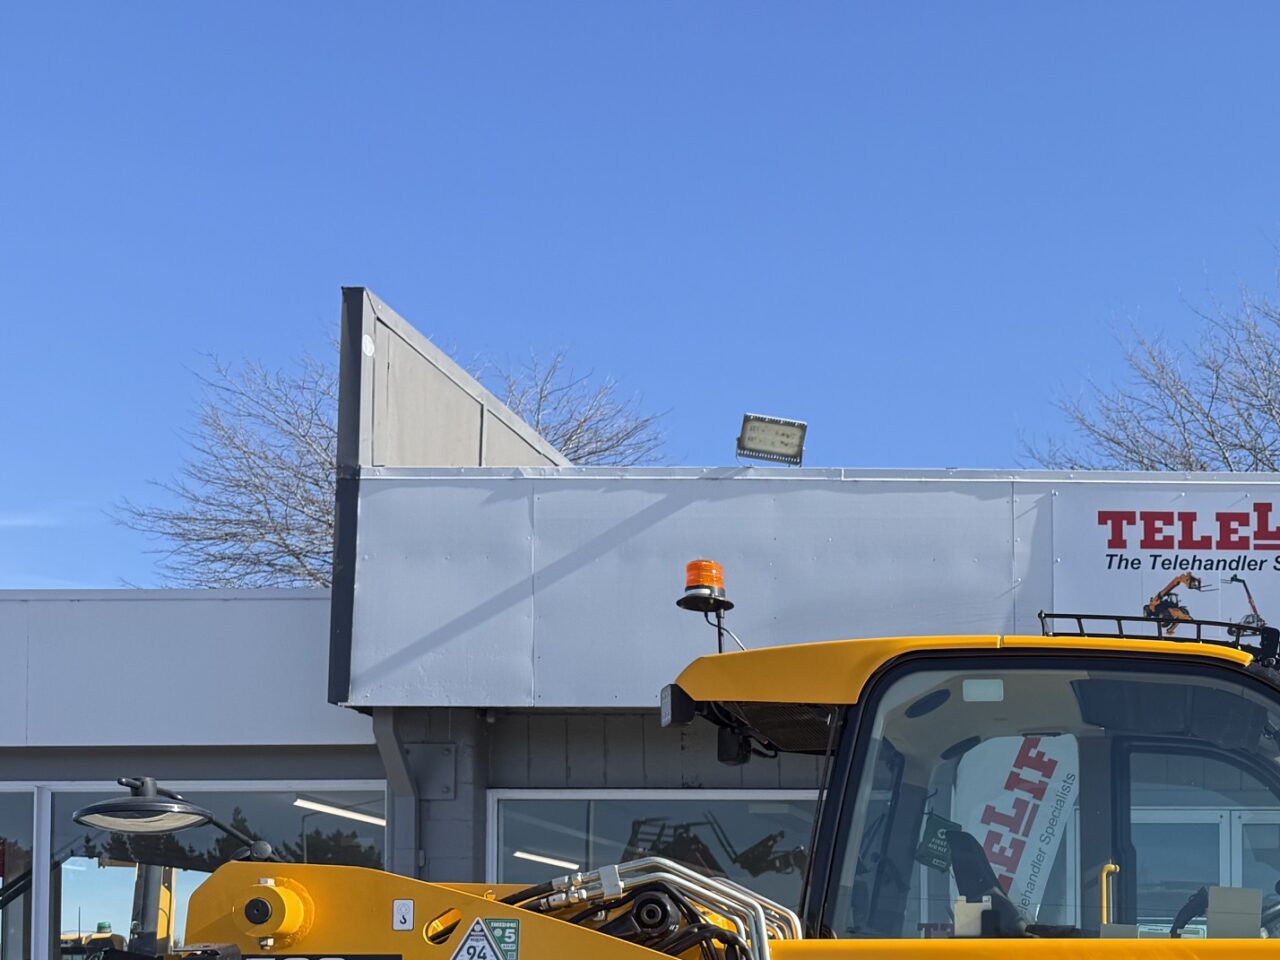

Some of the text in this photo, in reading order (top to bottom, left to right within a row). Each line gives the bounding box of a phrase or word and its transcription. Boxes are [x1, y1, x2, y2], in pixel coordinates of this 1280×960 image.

[1105, 553, 1142, 571] The
[1149, 554, 1267, 571] Telehandler
[1018, 772, 1076, 913] lehandler Specialists
[504, 928, 516, 942] 5
